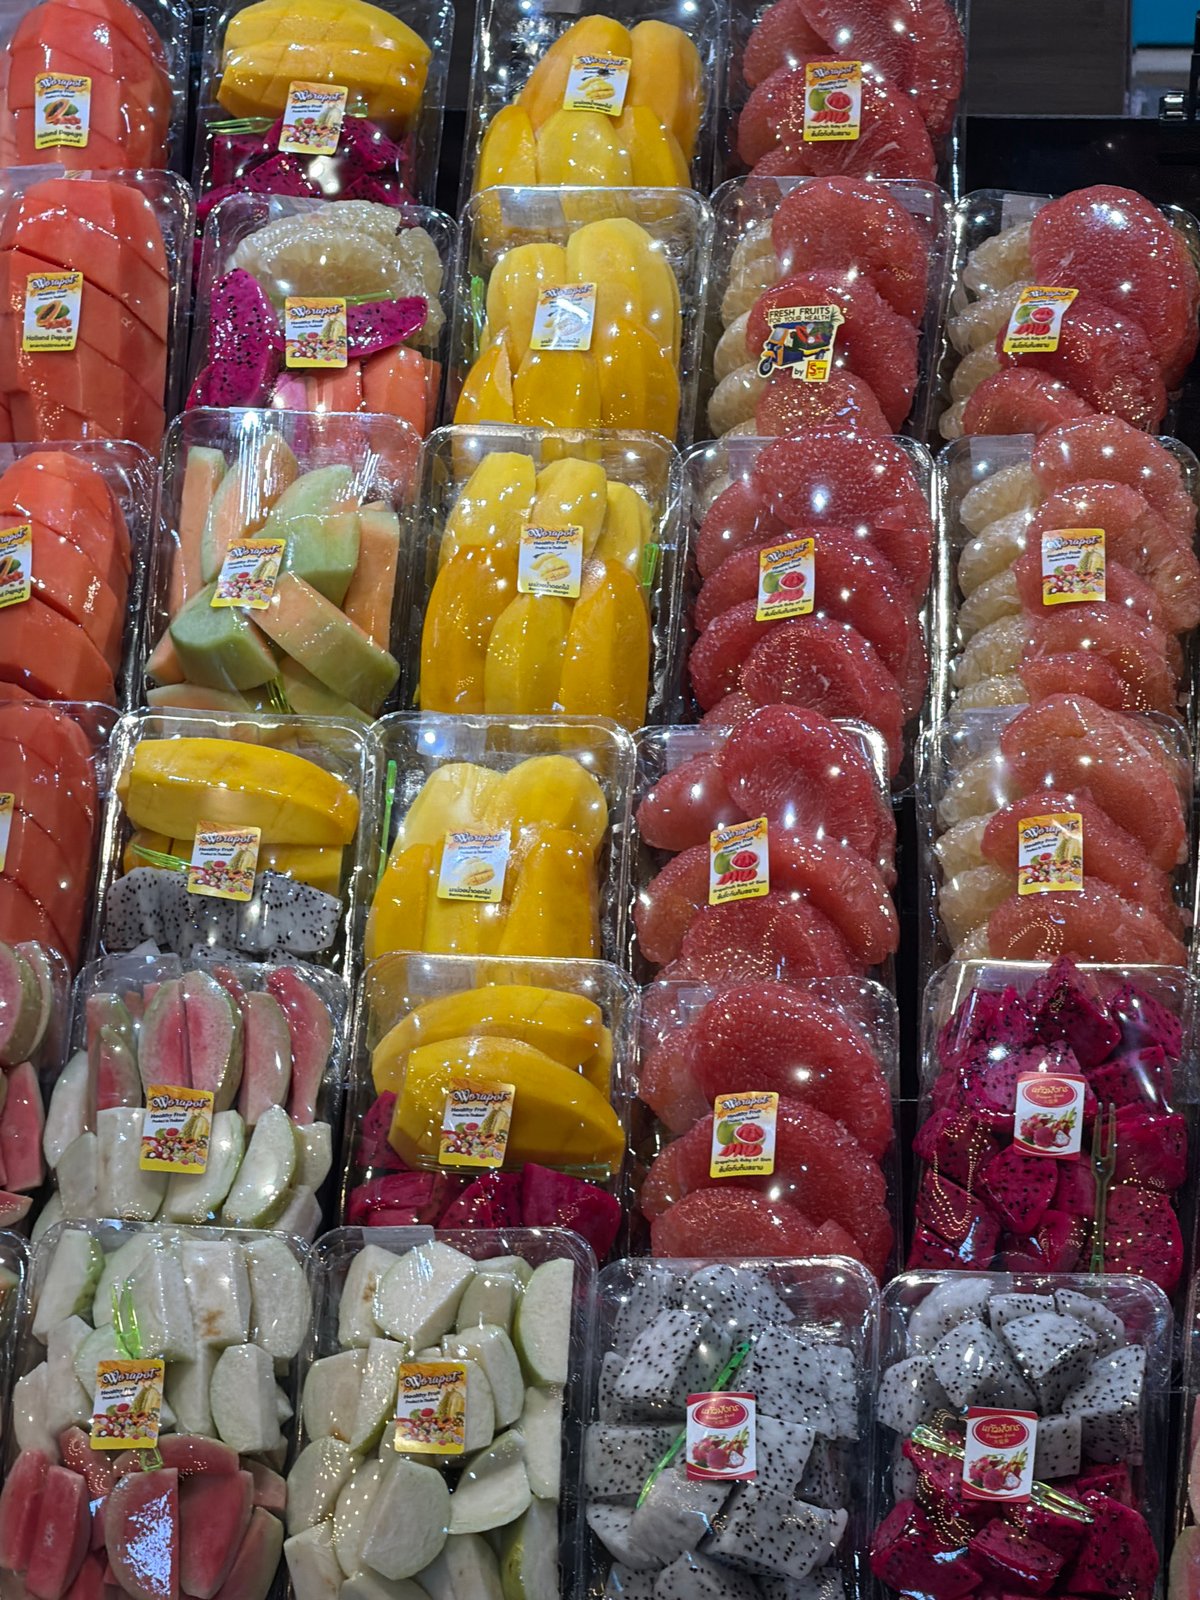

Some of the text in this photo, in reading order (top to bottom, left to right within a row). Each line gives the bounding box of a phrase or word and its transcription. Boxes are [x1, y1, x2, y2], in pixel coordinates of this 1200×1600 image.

[39, 77, 87, 91] Worapot
[292, 91, 344, 104] Worapot
[31, 276, 78, 291] Worapot
[289, 305, 343, 318] Worapot
[769, 306, 830, 318] FRESH FRUITS
[794, 368, 804, 377] by
[527, 529, 579, 541] Worapot
[1047, 536, 1101, 550] Worapot
[229, 546, 282, 560] Worapot
[766, 542, 809, 562] Worapot
[200, 832, 256, 847] Worapot
[715, 822, 762, 844] Worapot
[152, 1096, 209, 1111] Worapot
[451, 1090, 510, 1105] Worapot
[720, 1096, 773, 1111] Worapot
[99, 1368, 160, 1385] Worapot
[400, 1372, 462, 1389] Worapot
